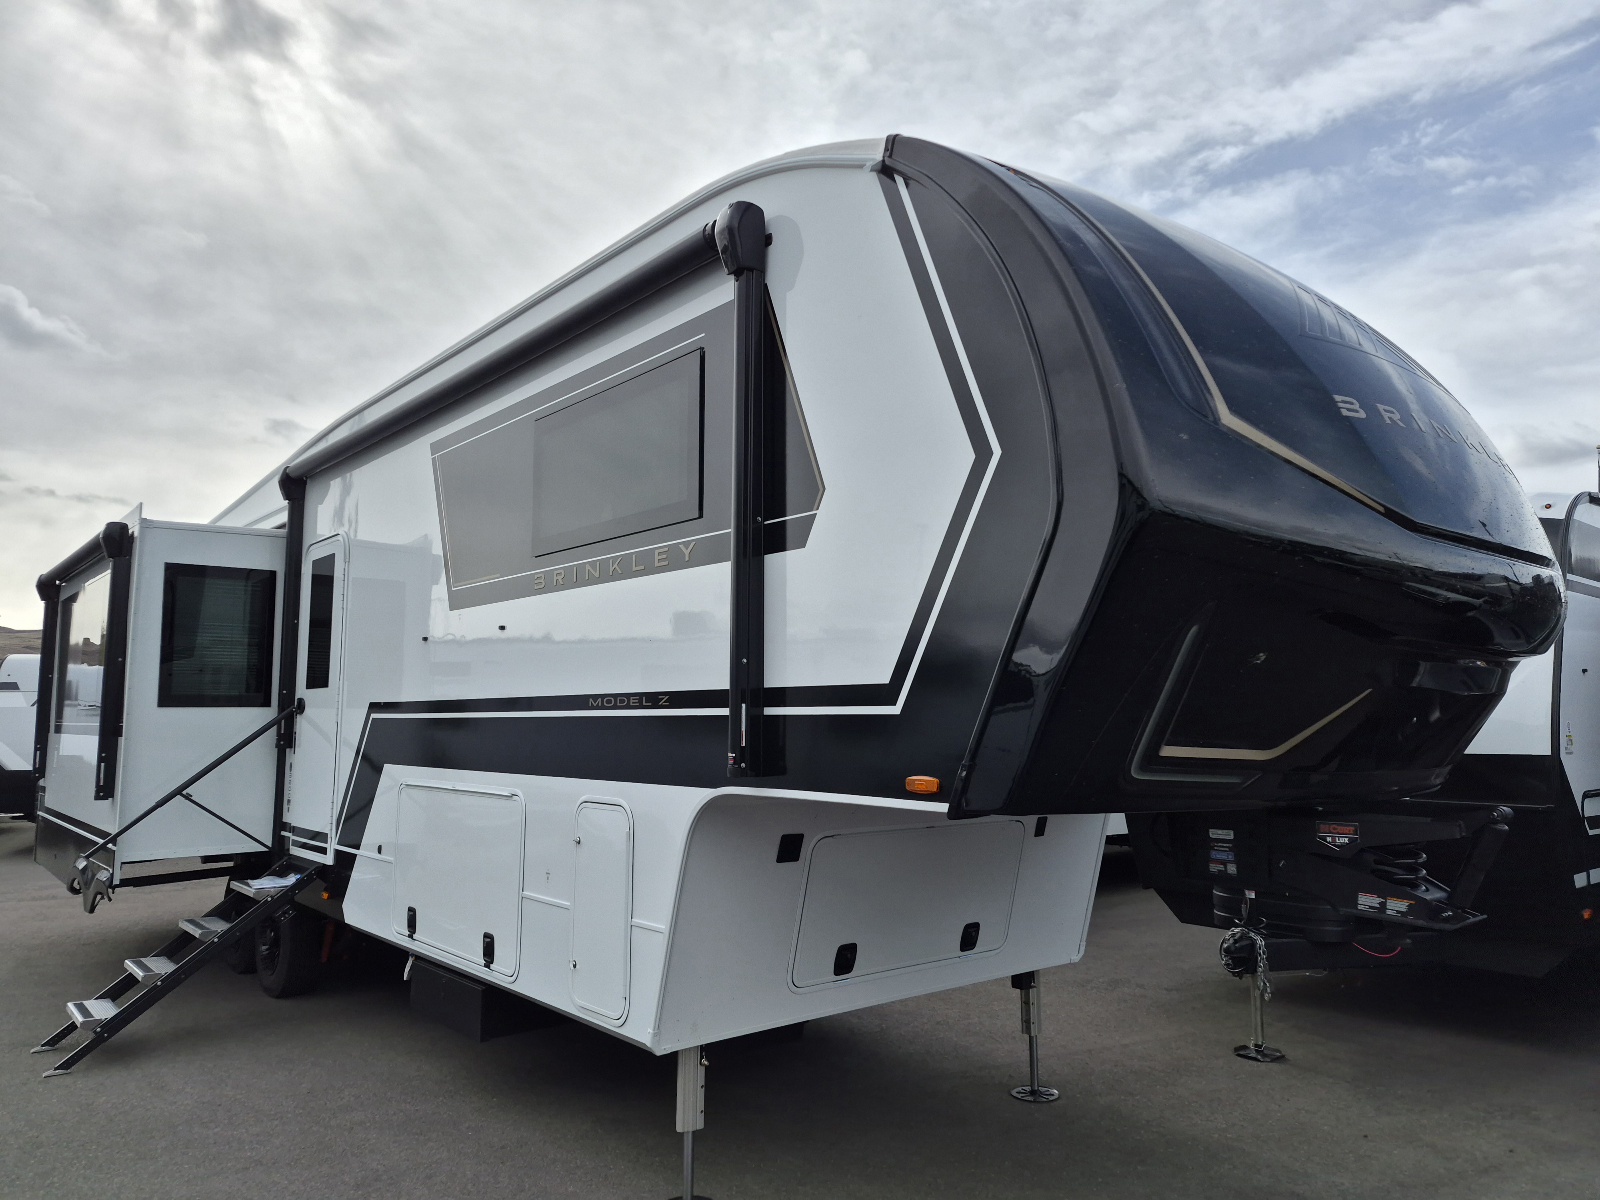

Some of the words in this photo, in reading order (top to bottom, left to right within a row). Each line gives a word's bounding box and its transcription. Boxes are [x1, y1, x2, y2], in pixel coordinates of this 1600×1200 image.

[534, 542, 696, 590] BRINKLEY
[589, 697, 652, 707] MODEL
[658, 695, 670, 706] Z
